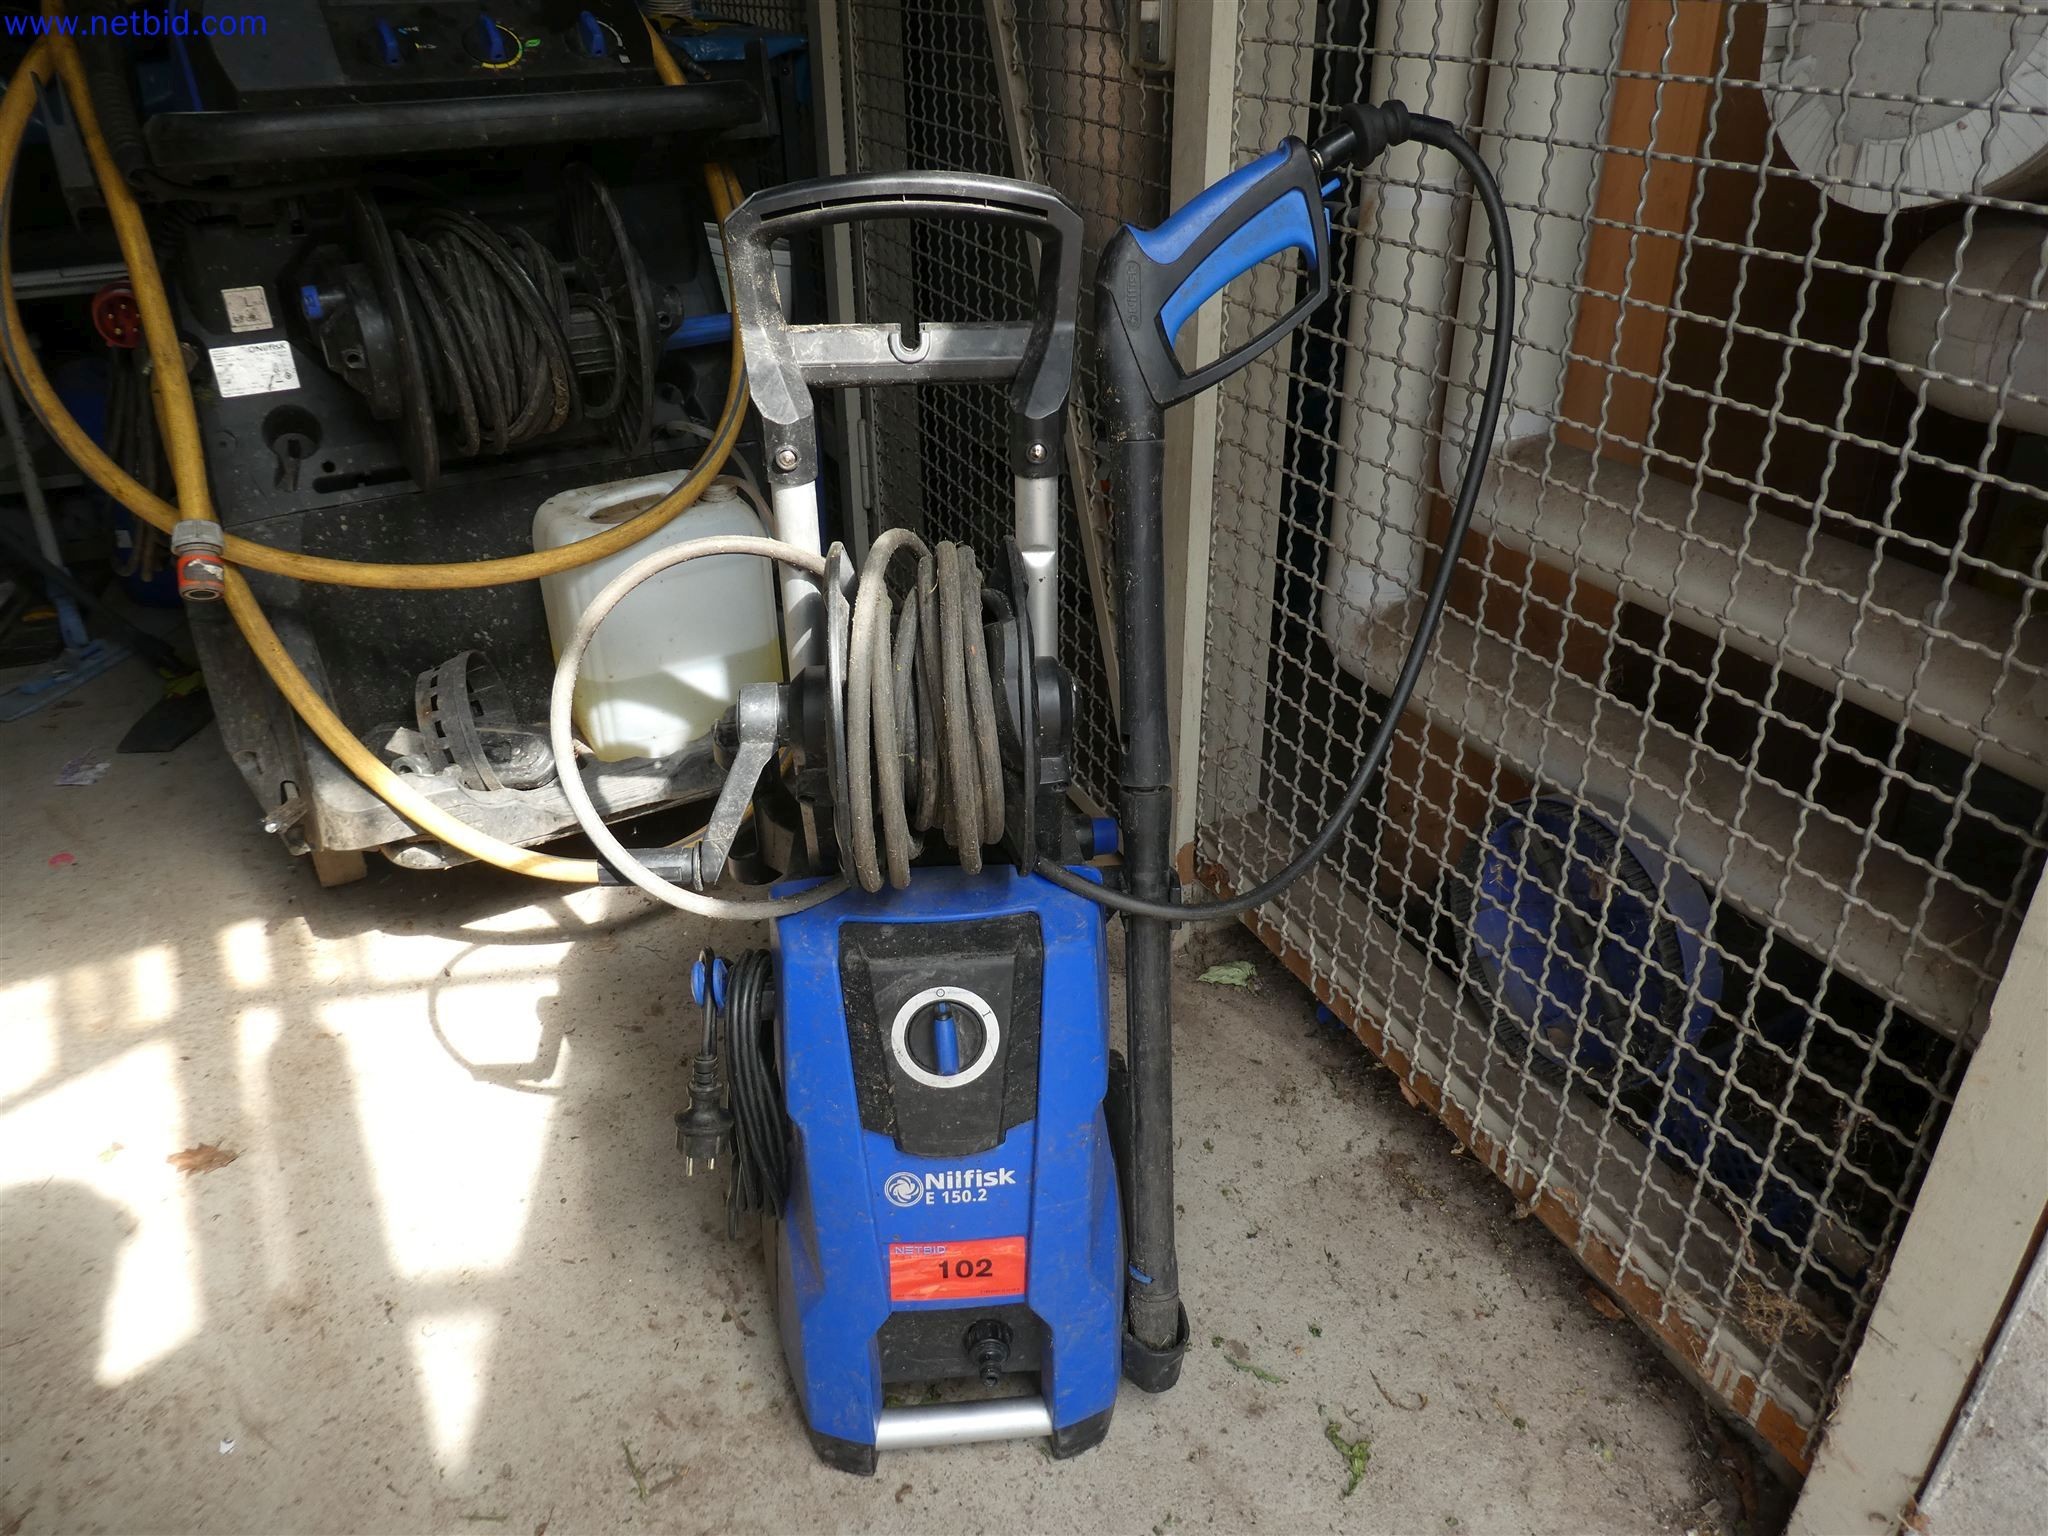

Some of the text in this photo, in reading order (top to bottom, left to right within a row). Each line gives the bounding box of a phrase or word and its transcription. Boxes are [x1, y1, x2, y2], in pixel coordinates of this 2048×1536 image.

[925, 1168, 1016, 1190] Nilfisk
[925, 1189, 988, 1205] E 150.2
[895, 1245, 946, 1255] NETBID
[938, 1259, 993, 1279] 102
